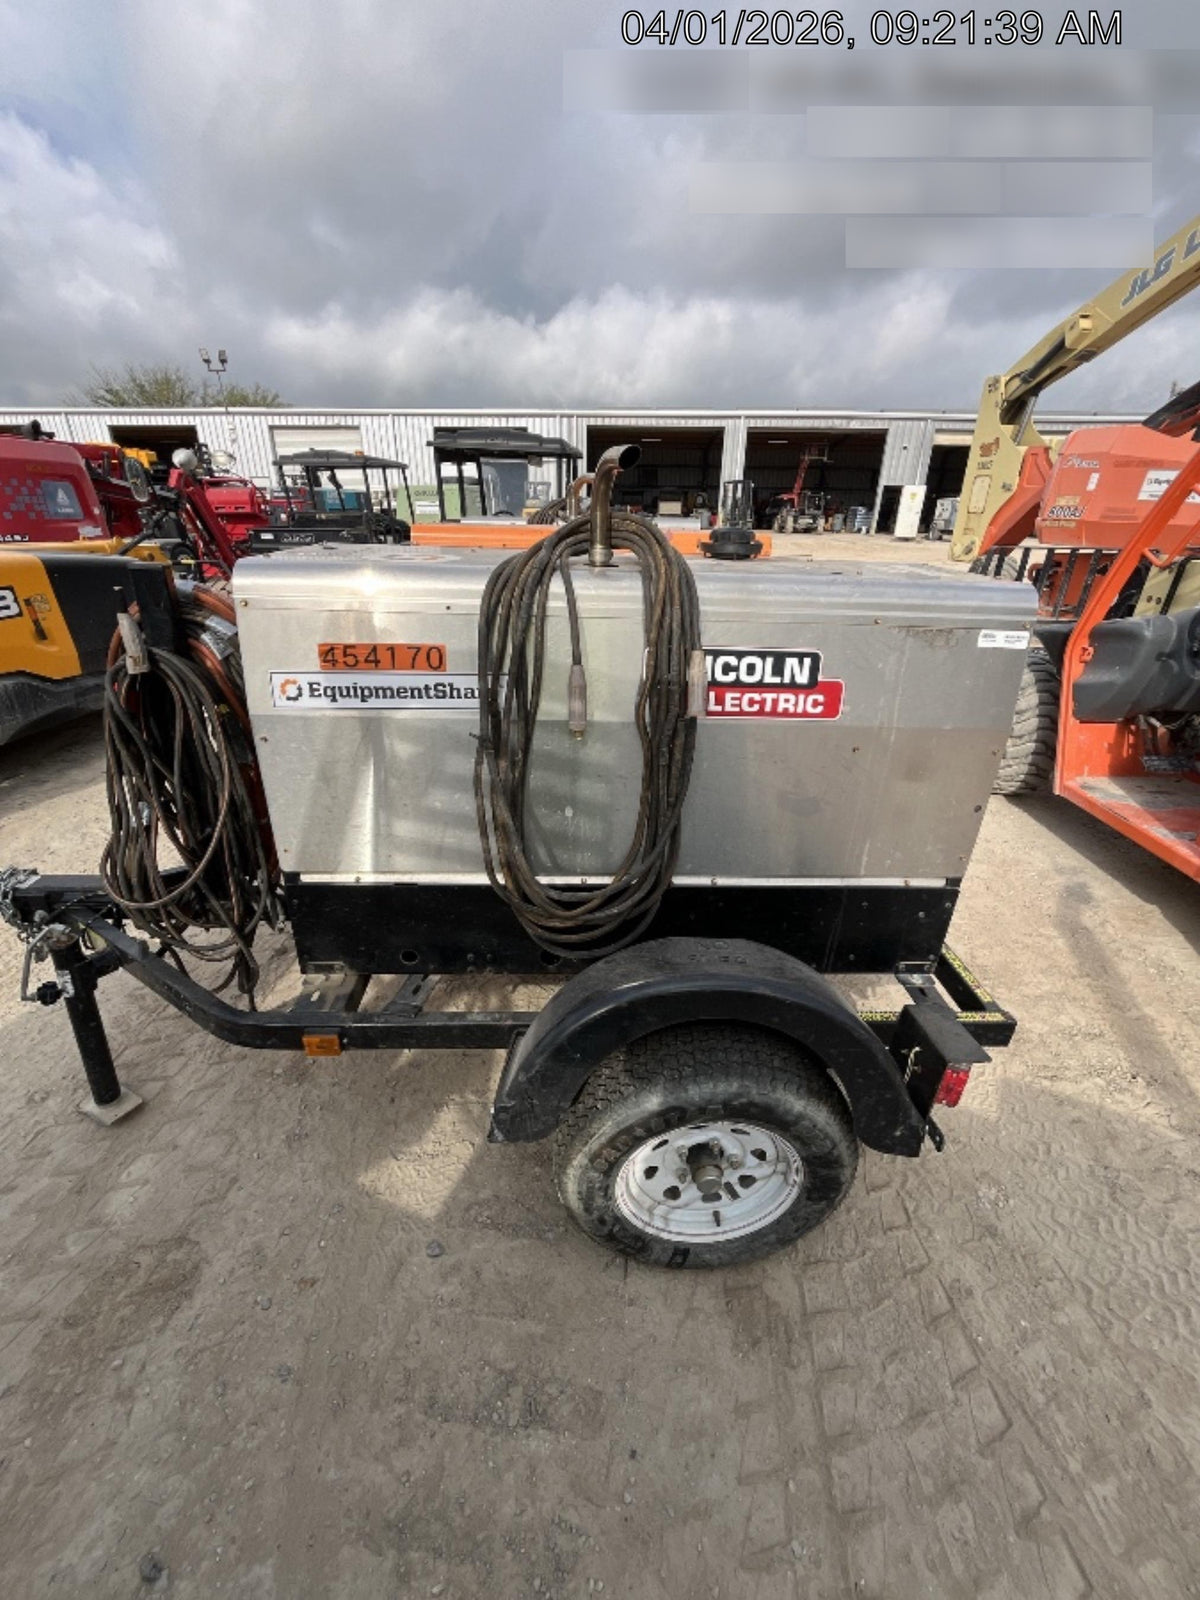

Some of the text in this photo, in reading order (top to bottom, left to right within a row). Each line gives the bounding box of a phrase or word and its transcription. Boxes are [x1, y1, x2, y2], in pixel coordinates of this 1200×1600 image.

[1121, 246, 1177, 306] JLG
[321, 645, 444, 670] 454170
[707, 691, 825, 714] LECTRIC
